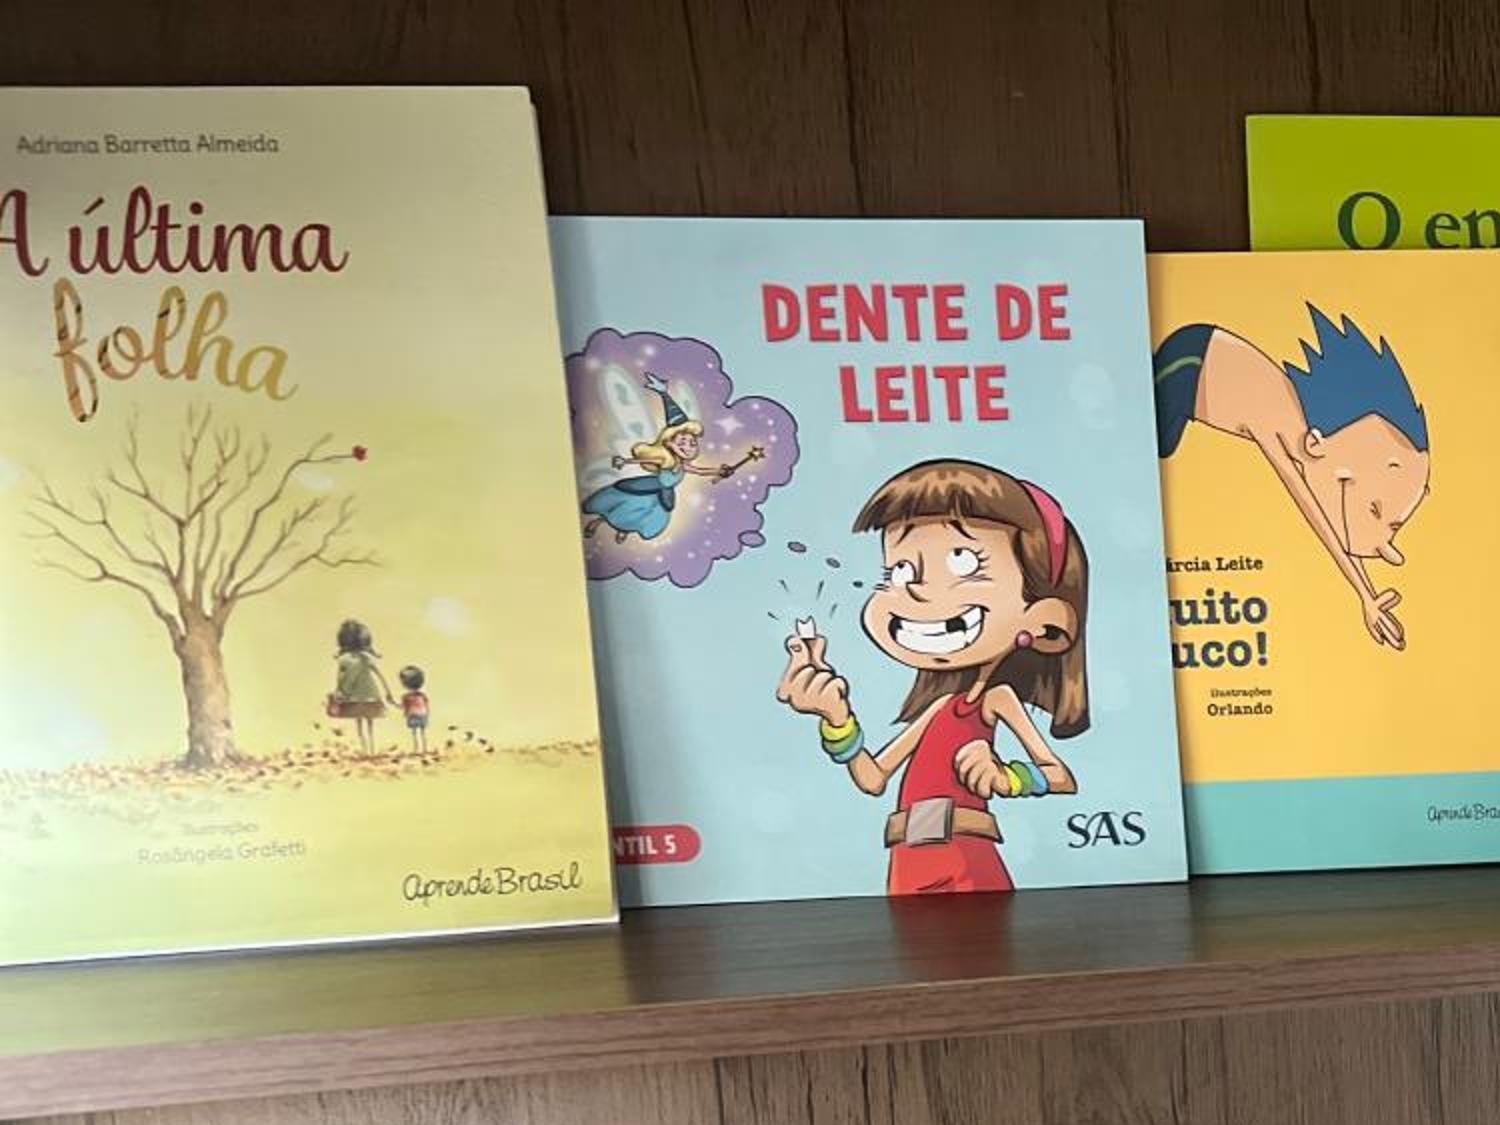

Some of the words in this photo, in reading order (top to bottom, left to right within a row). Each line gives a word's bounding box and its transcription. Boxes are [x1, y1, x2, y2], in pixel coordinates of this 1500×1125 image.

[17, 135, 99, 154] Adriana
[105, 134, 190, 154] Barretta
[196, 133, 279, 153] Almeida
[0, 189, 49, 277] A
[69, 185, 349, 274] última
[1337, 191, 1401, 250] O
[761, 282, 966, 342] DENTE
[994, 282, 1071, 341] DE
[52, 277, 298, 423] folha
[838, 363, 1010, 423] LEITE
[1216, 555, 1263, 571] Leite
[1169, 587, 1268, 627] uito
[1207, 703, 1273, 716] Orlando
[663, 833, 678, 856] 5
[1066, 810, 1147, 849] SAS
